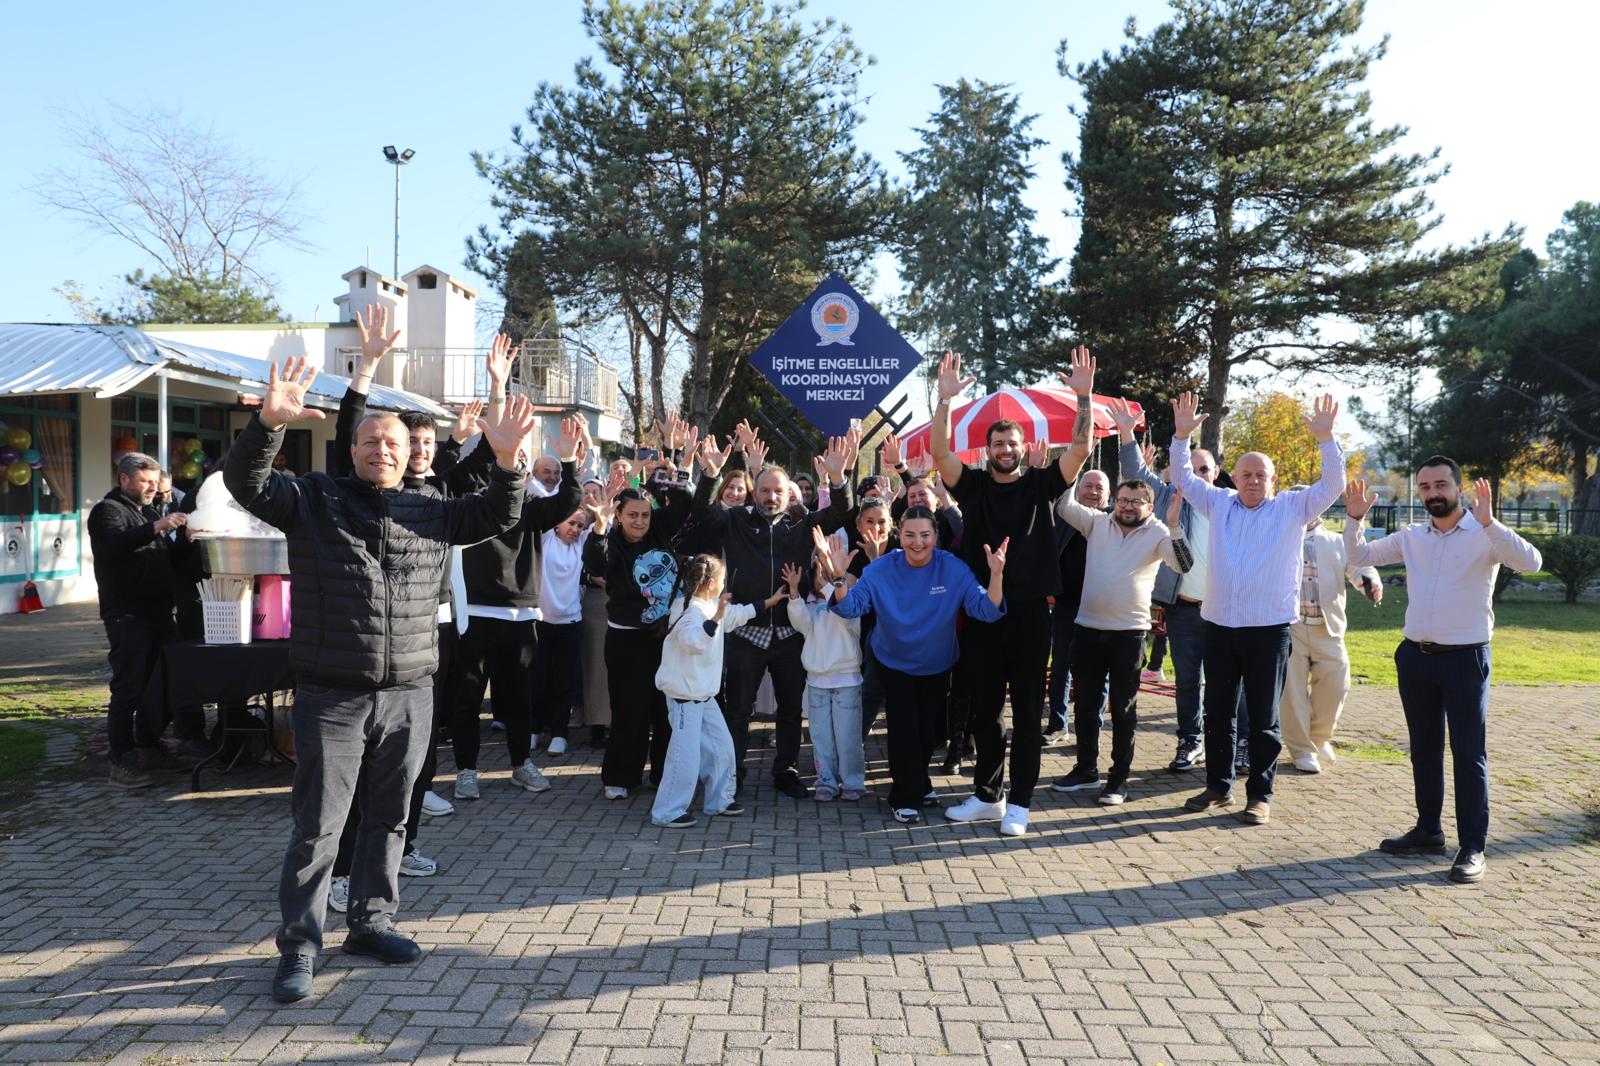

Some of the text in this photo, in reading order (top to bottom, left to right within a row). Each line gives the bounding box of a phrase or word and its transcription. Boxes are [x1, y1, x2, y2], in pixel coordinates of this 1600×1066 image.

[772, 356, 900, 372] İŞİTME ENGELLİLER
[781, 372, 890, 386] KOORDİNASYON
[806, 387, 865, 401] MERKEZİ
